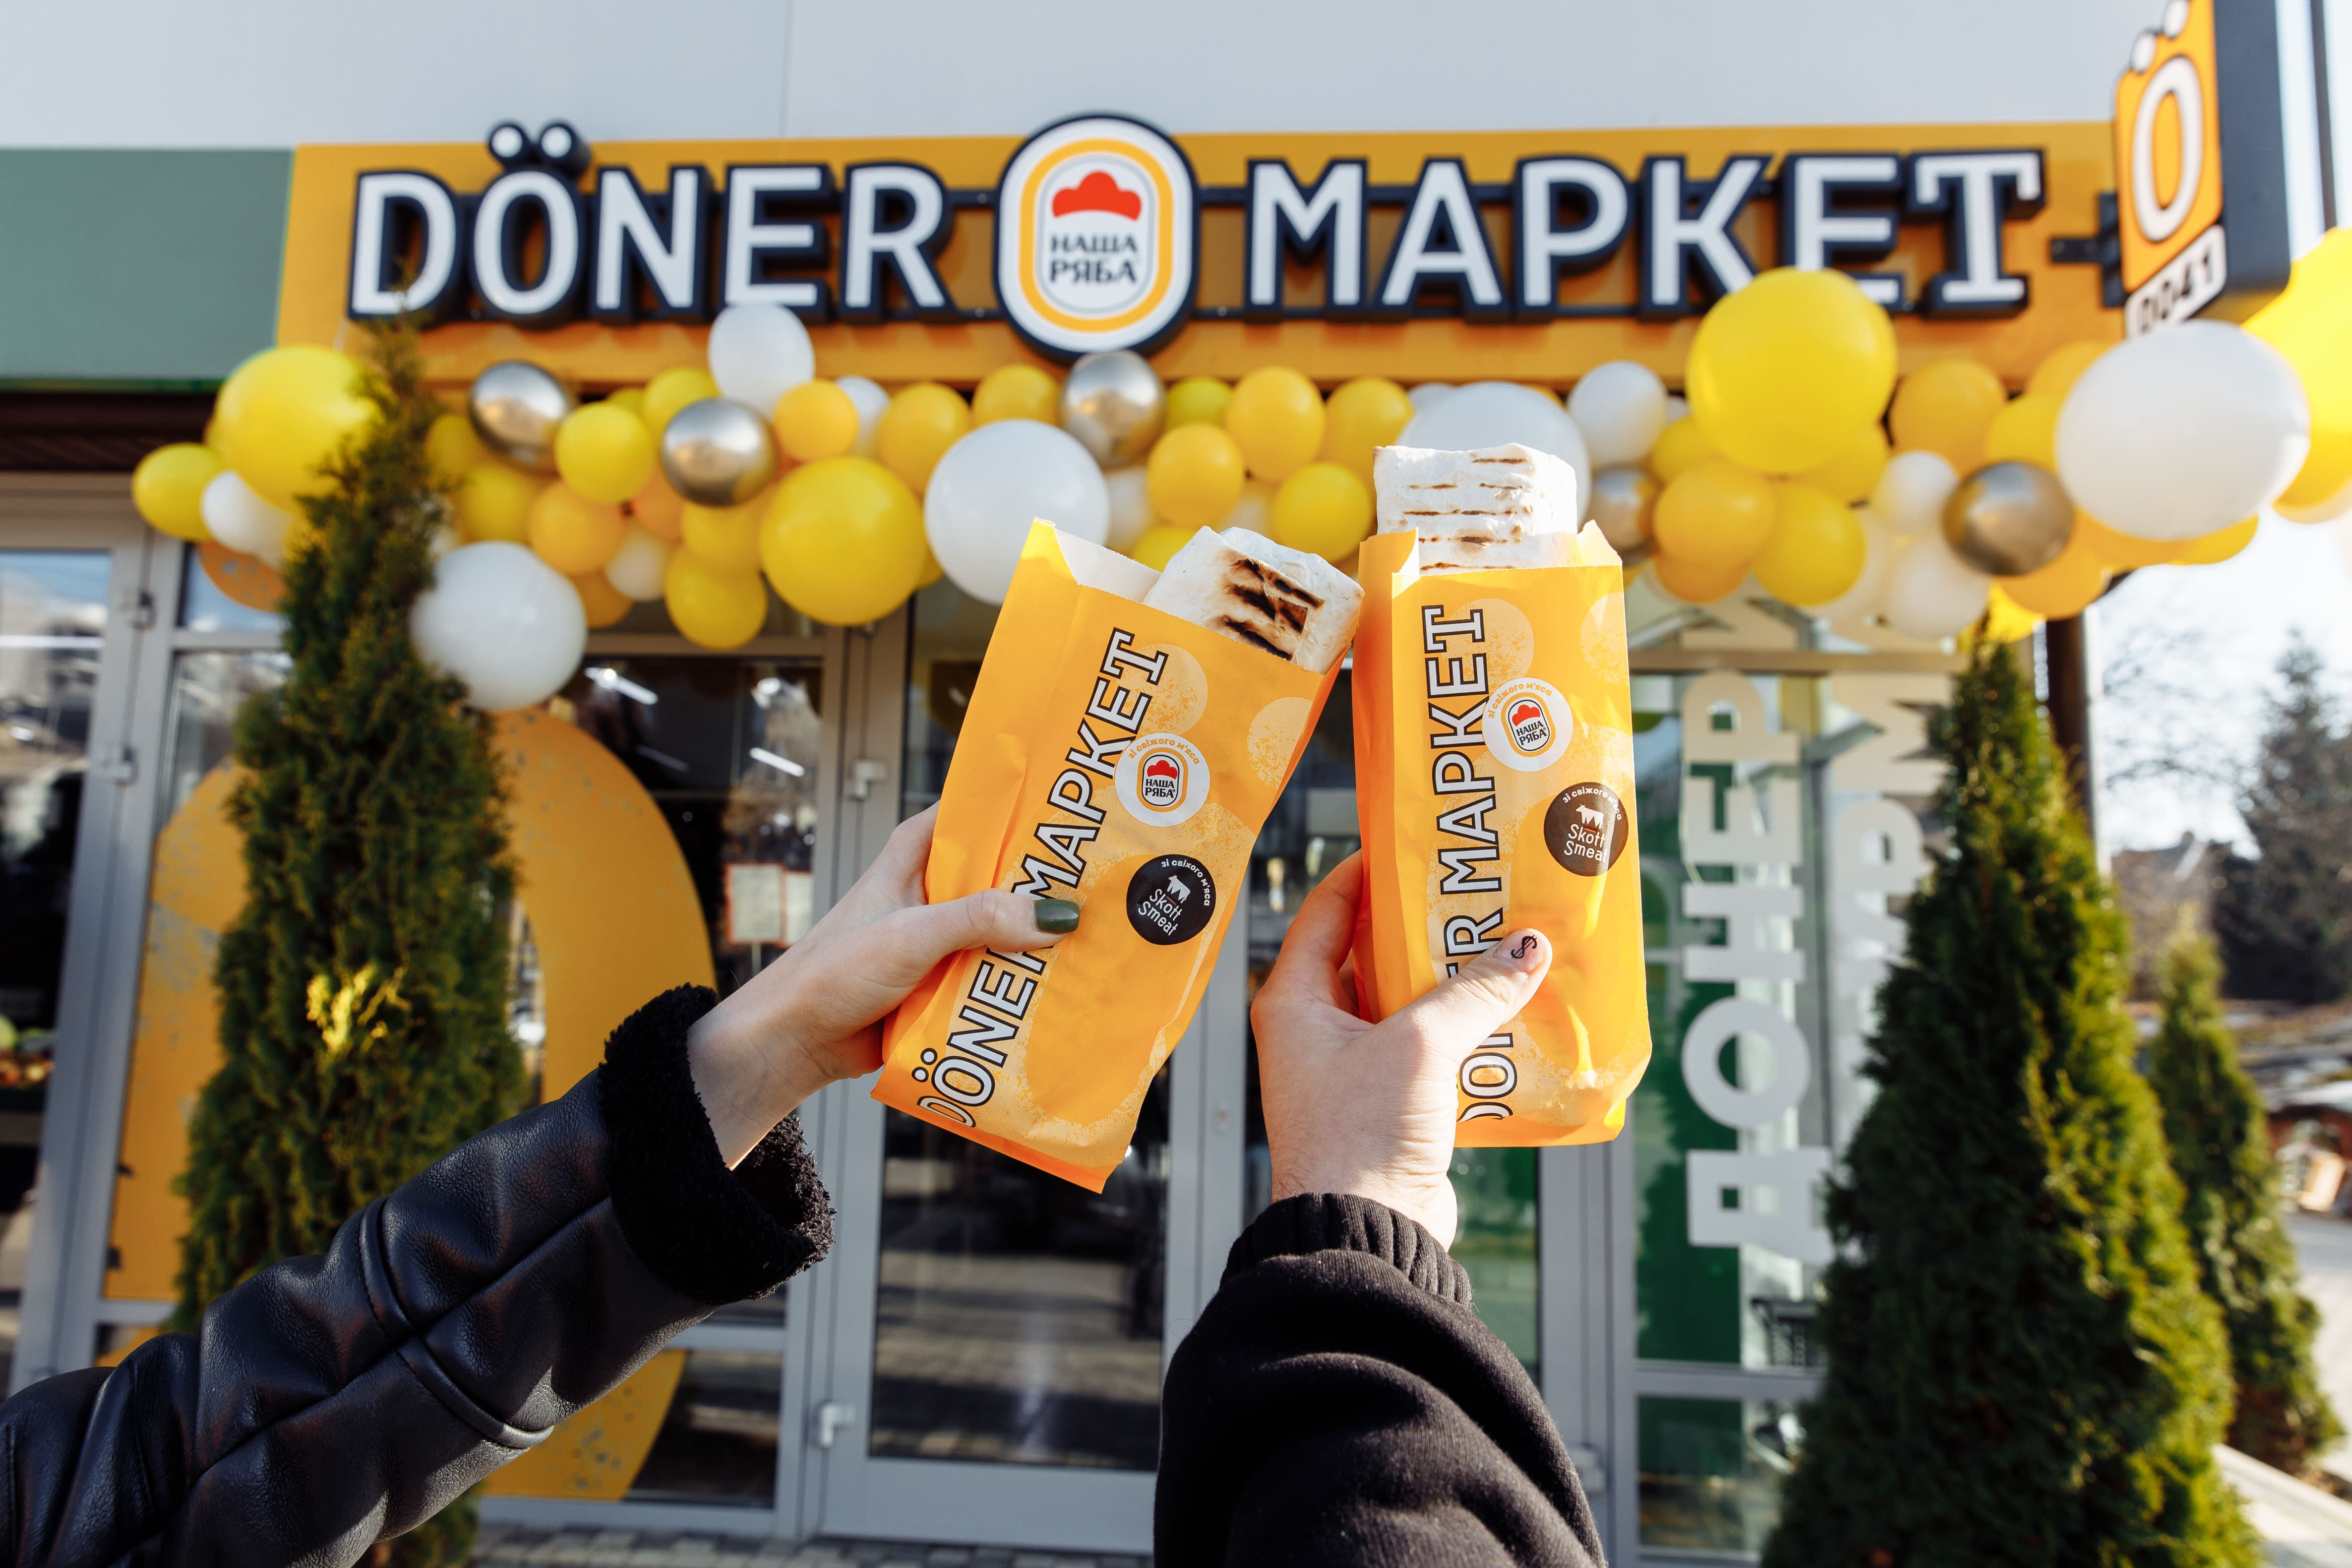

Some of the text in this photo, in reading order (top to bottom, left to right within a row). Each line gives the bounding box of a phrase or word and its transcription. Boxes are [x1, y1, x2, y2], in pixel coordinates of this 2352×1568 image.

[350, 121, 951, 316] DÖNER
[1050, 235, 1137, 252] НАША
[1050, 260, 1136, 282] РЯБА
[1488, 709, 1495, 719] зі
[1492, 683, 1524, 710] свіжого
[1516, 720, 1544, 736] НАША
[1129, 749, 1137, 759] зі
[1137, 738, 1175, 752] свіжого
[1145, 779, 1175, 788] НАША
[1563, 793, 1571, 803] зі
[1571, 786, 1607, 798] свіжого
[1568, 824, 1605, 848] Skott
[1564, 840, 1608, 863] Smeat
[1161, 858, 1169, 868] зі
[1171, 859, 1203, 878] свіжого
[1149, 889, 1183, 921] Skott
[1138, 901, 1178, 936] Smeat
